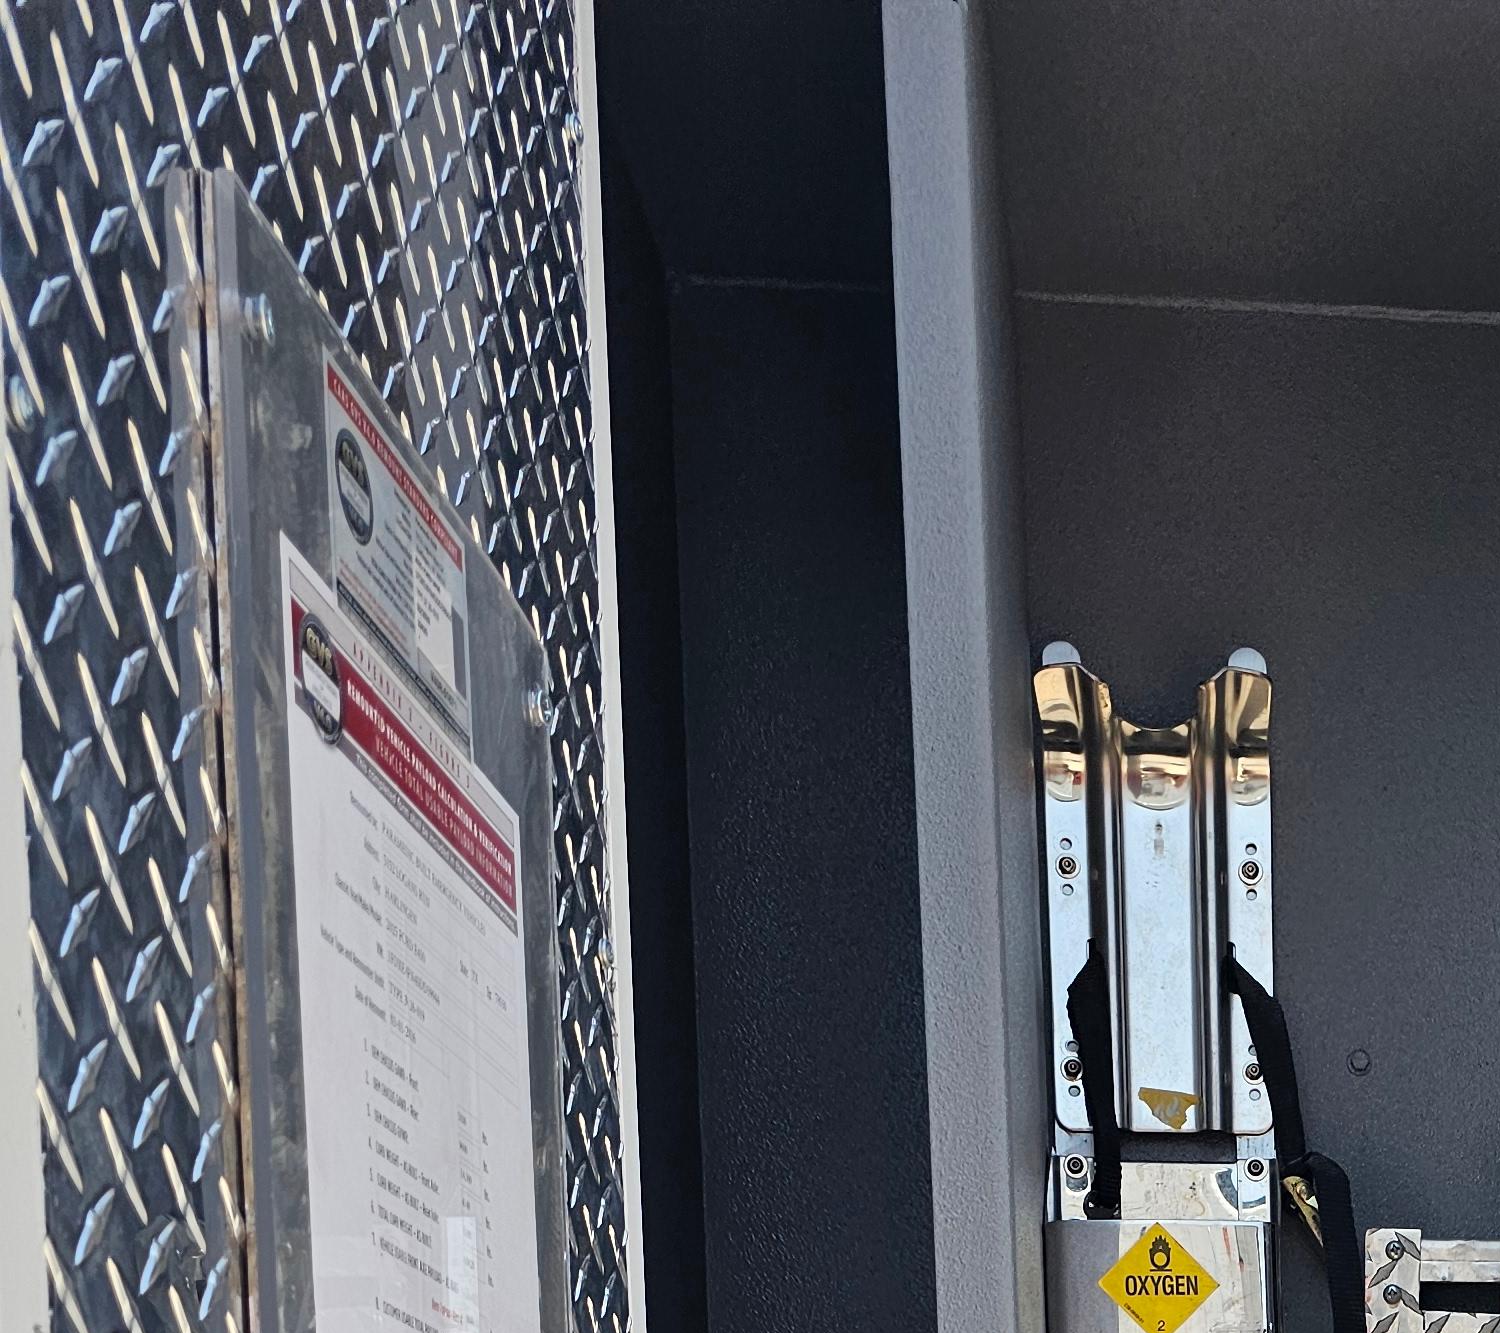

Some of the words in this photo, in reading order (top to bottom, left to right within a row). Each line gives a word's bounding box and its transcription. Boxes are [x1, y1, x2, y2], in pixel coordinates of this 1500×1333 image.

[374, 733, 403, 781] VEHICLE
[403, 765, 423, 804] TOTAL
[449, 816, 474, 860] PAYLOAD
[385, 722, 410, 765] VEHICLE
[410, 750, 437, 795] PAYLOAD
[437, 780, 473, 835] CALCULATION
[478, 827, 512, 879] VERIFICATION
[1125, 1275, 1199, 1296] OXYGEN
[1157, 1320, 1166, 1332] 2
